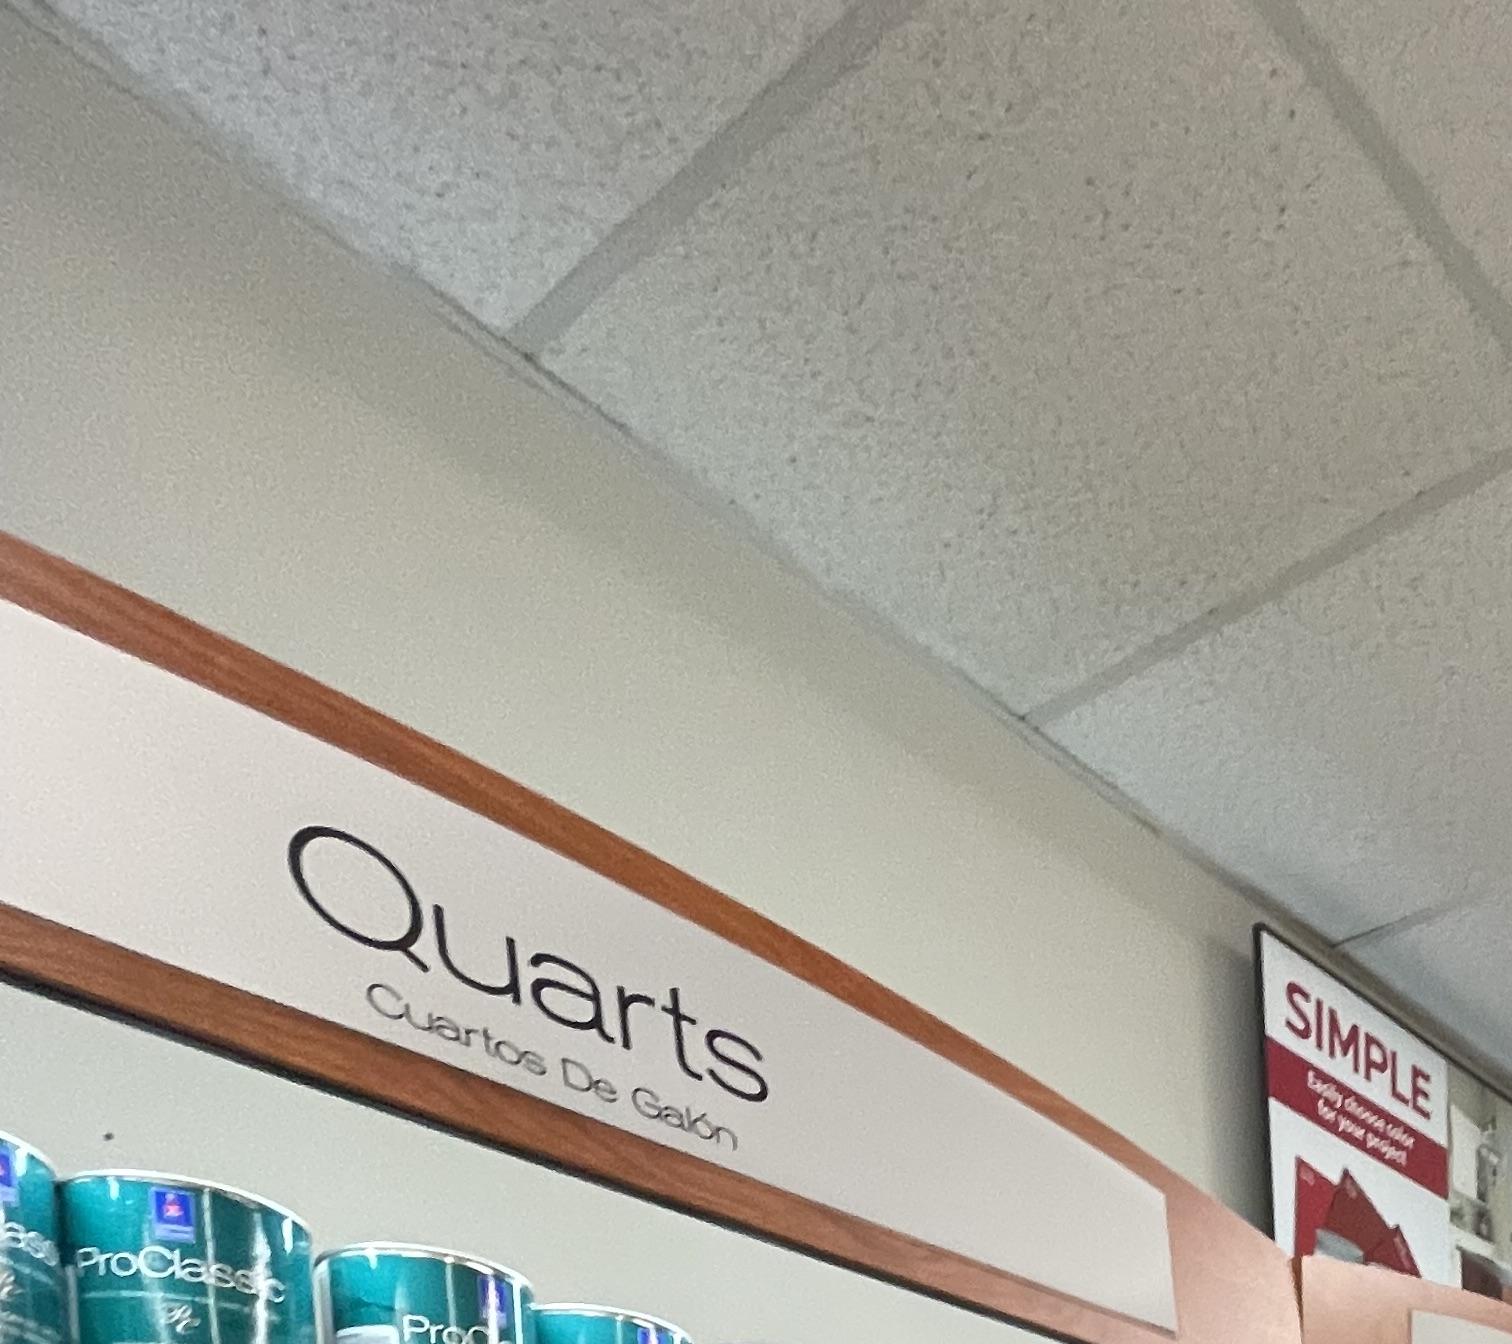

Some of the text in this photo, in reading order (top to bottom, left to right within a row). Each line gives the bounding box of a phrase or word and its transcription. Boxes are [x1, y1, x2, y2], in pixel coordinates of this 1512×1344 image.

[287, 826, 768, 1103] Quarts
[367, 984, 738, 1152] Cuartos De Galón
[1285, 982, 1431, 1120] SIMPLE
